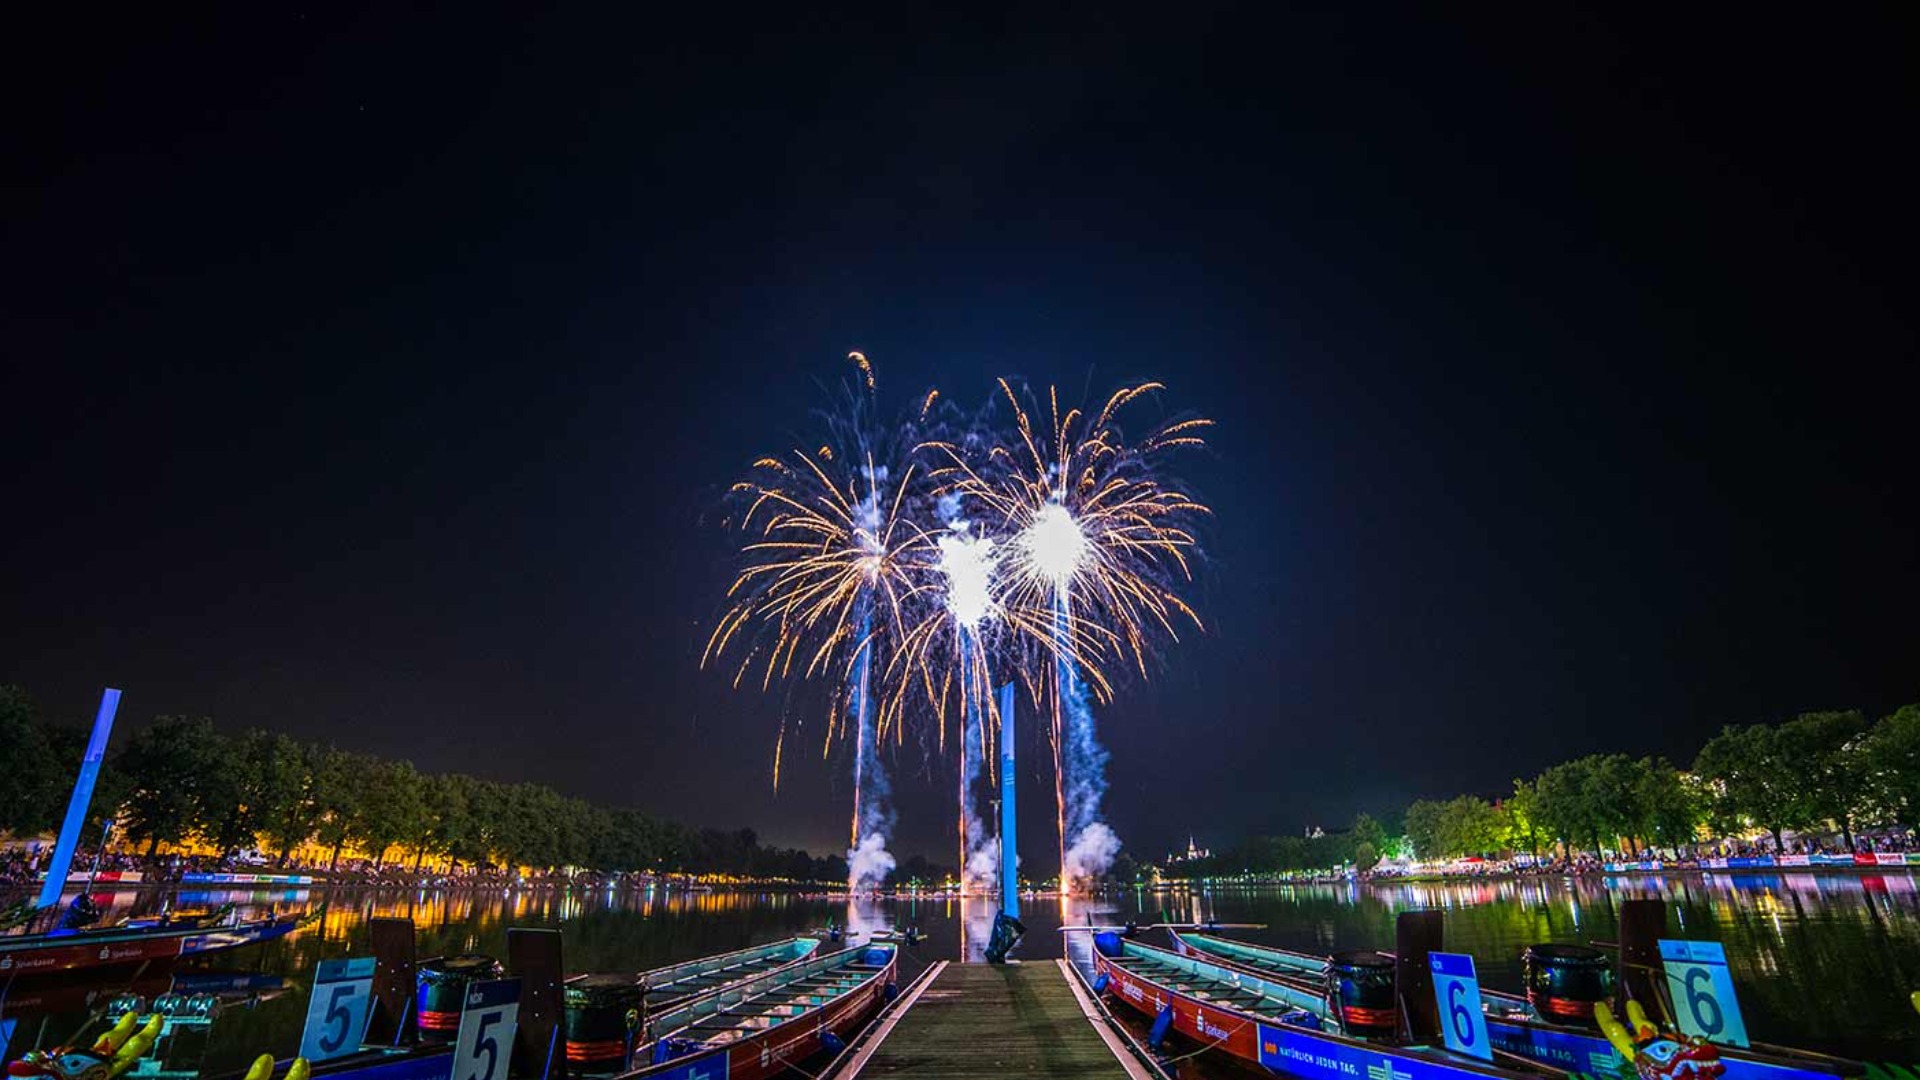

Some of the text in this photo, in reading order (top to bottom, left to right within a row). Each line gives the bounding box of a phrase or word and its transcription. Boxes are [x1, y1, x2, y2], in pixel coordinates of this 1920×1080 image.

[318, 985, 355, 1053] 5
[1447, 980, 1475, 1048] 6
[1685, 967, 1724, 1035] 6
[468, 1011, 503, 1080] 5
[1279, 1046, 1360, 1076] NATÜRLICH JEDEN TAG.
